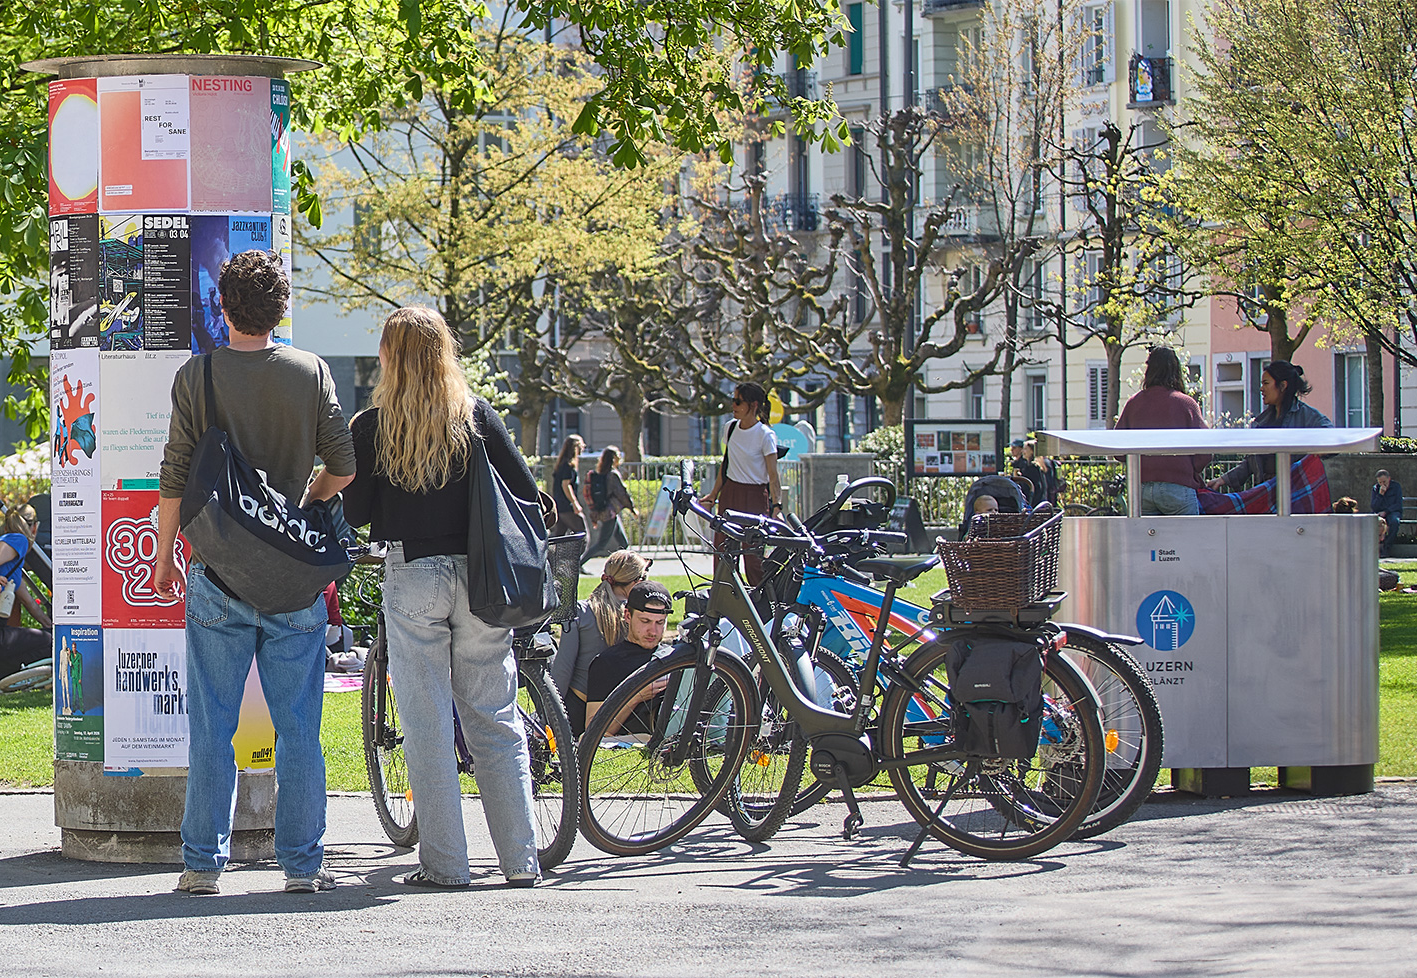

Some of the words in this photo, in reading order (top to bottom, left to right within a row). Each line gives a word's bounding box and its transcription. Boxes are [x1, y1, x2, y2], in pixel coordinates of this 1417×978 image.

[191, 78, 252, 92] NESTING
[144, 216, 189, 230] SEDEL
[146, 412, 158, 420] Tief
[109, 444, 129, 452] fliegen
[70, 627, 99, 638] Inspiration
[118, 647, 158, 670] luzerner
[1145, 660, 1194, 672] UZERN
[115, 664, 179, 692] handwerks
